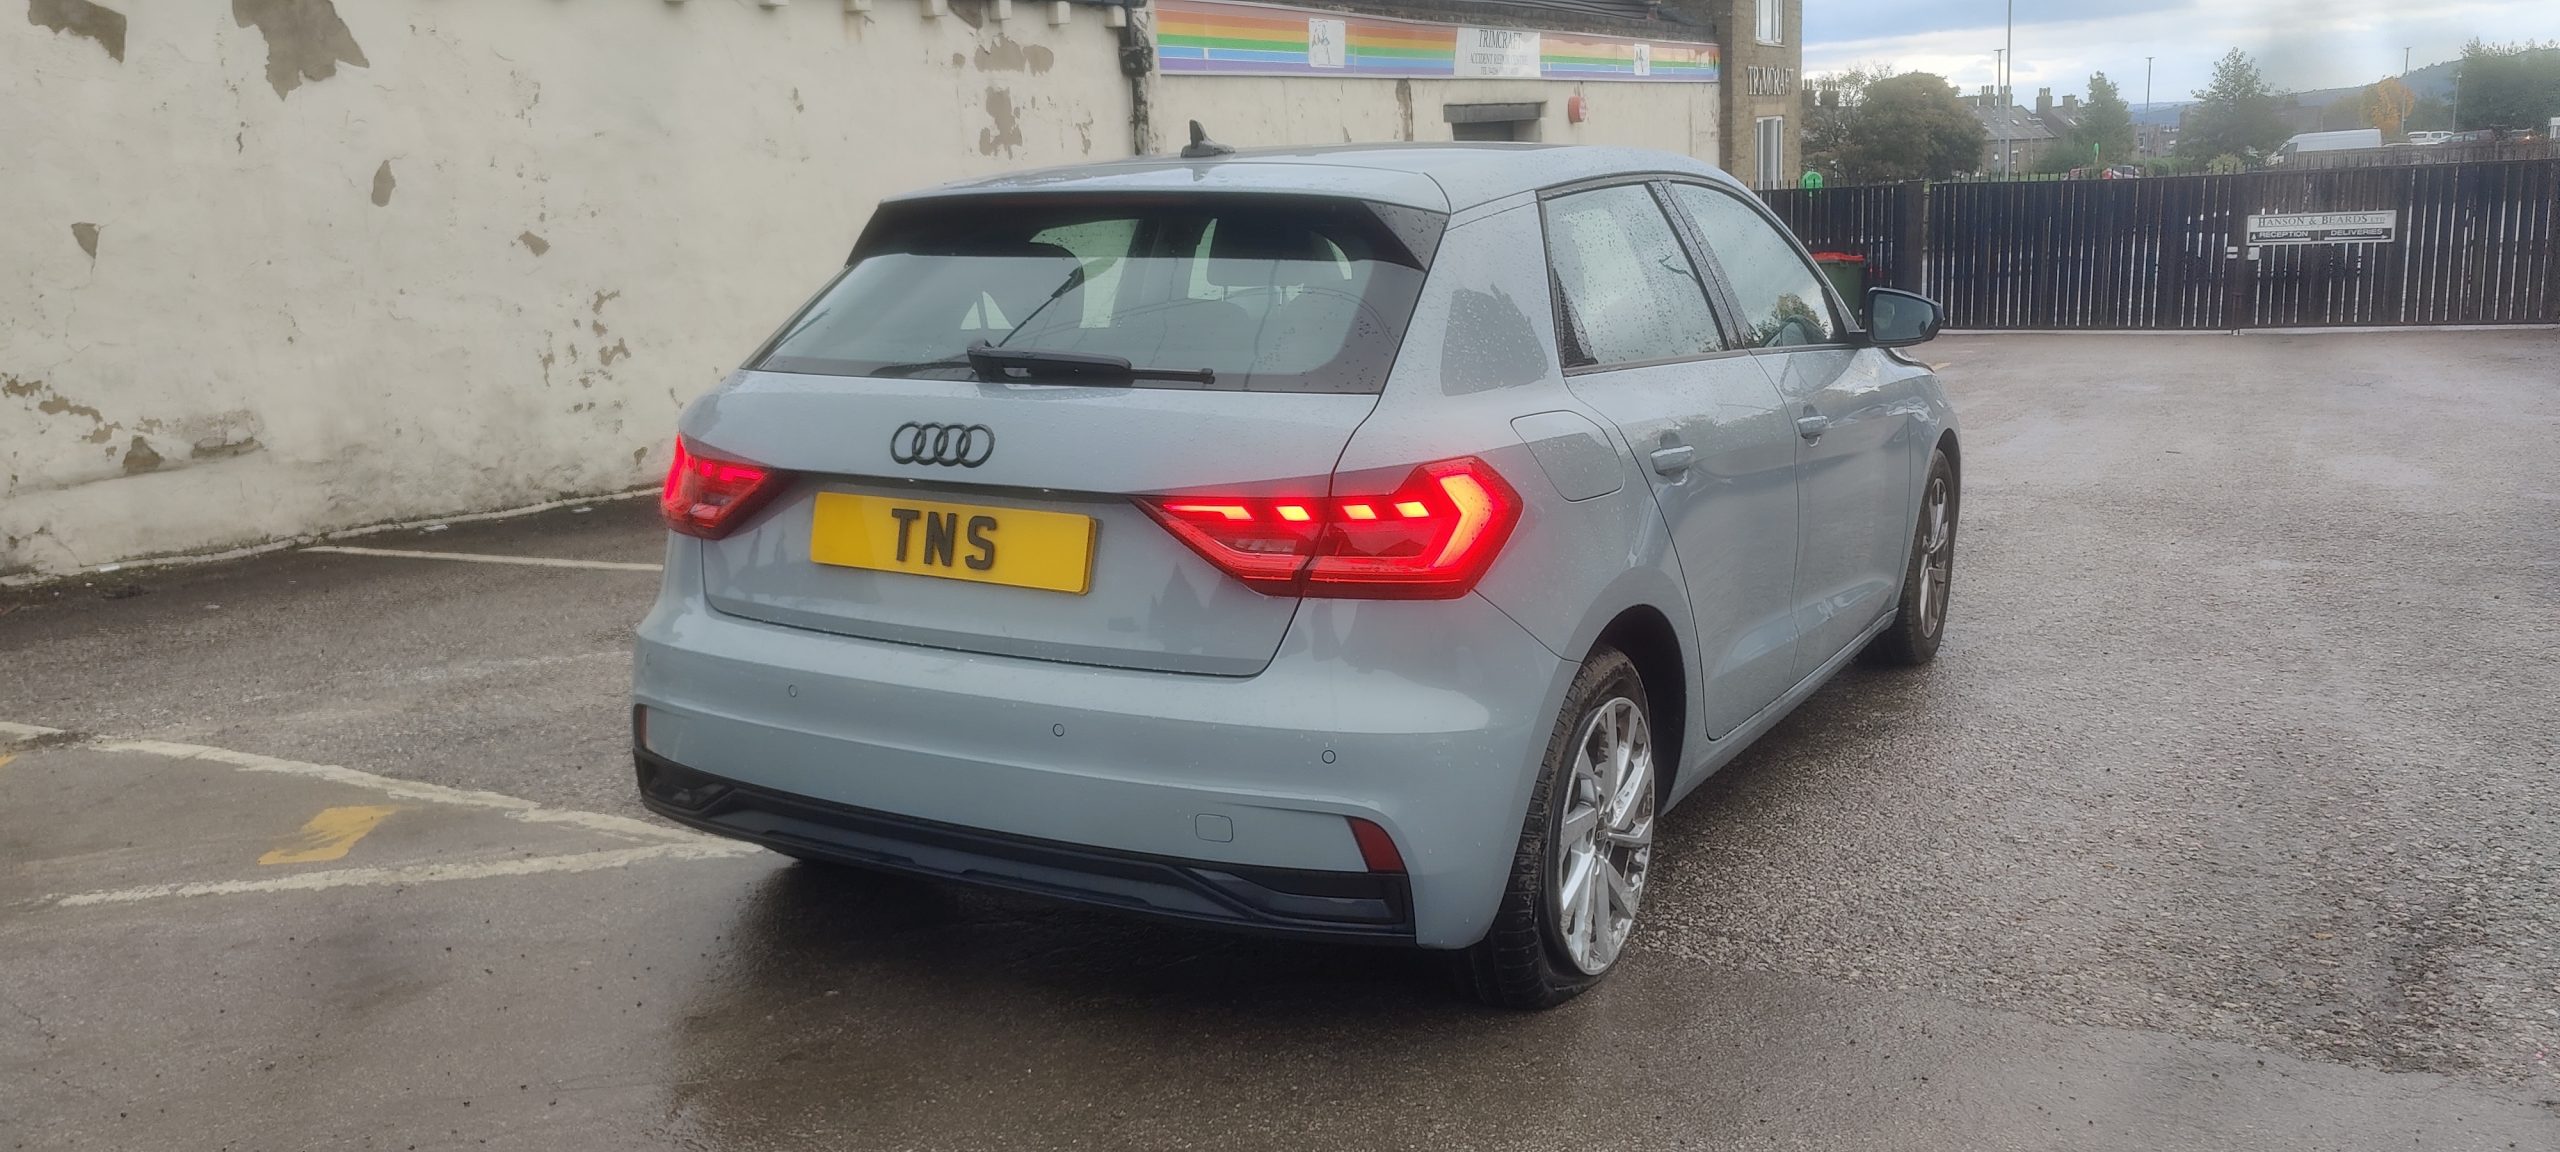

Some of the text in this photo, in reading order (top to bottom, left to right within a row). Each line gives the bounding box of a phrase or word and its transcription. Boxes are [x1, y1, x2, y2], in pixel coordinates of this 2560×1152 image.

[1479, 30, 1522, 49] TRIMCRAFT
[2258, 215, 2304, 227] HANSON
[2309, 216, 2318, 226] &
[2322, 214, 2368, 225] BEARDS
[2259, 228, 2383, 239] RECEPTION DELIVERIES
[892, 508, 997, 571] TNS
